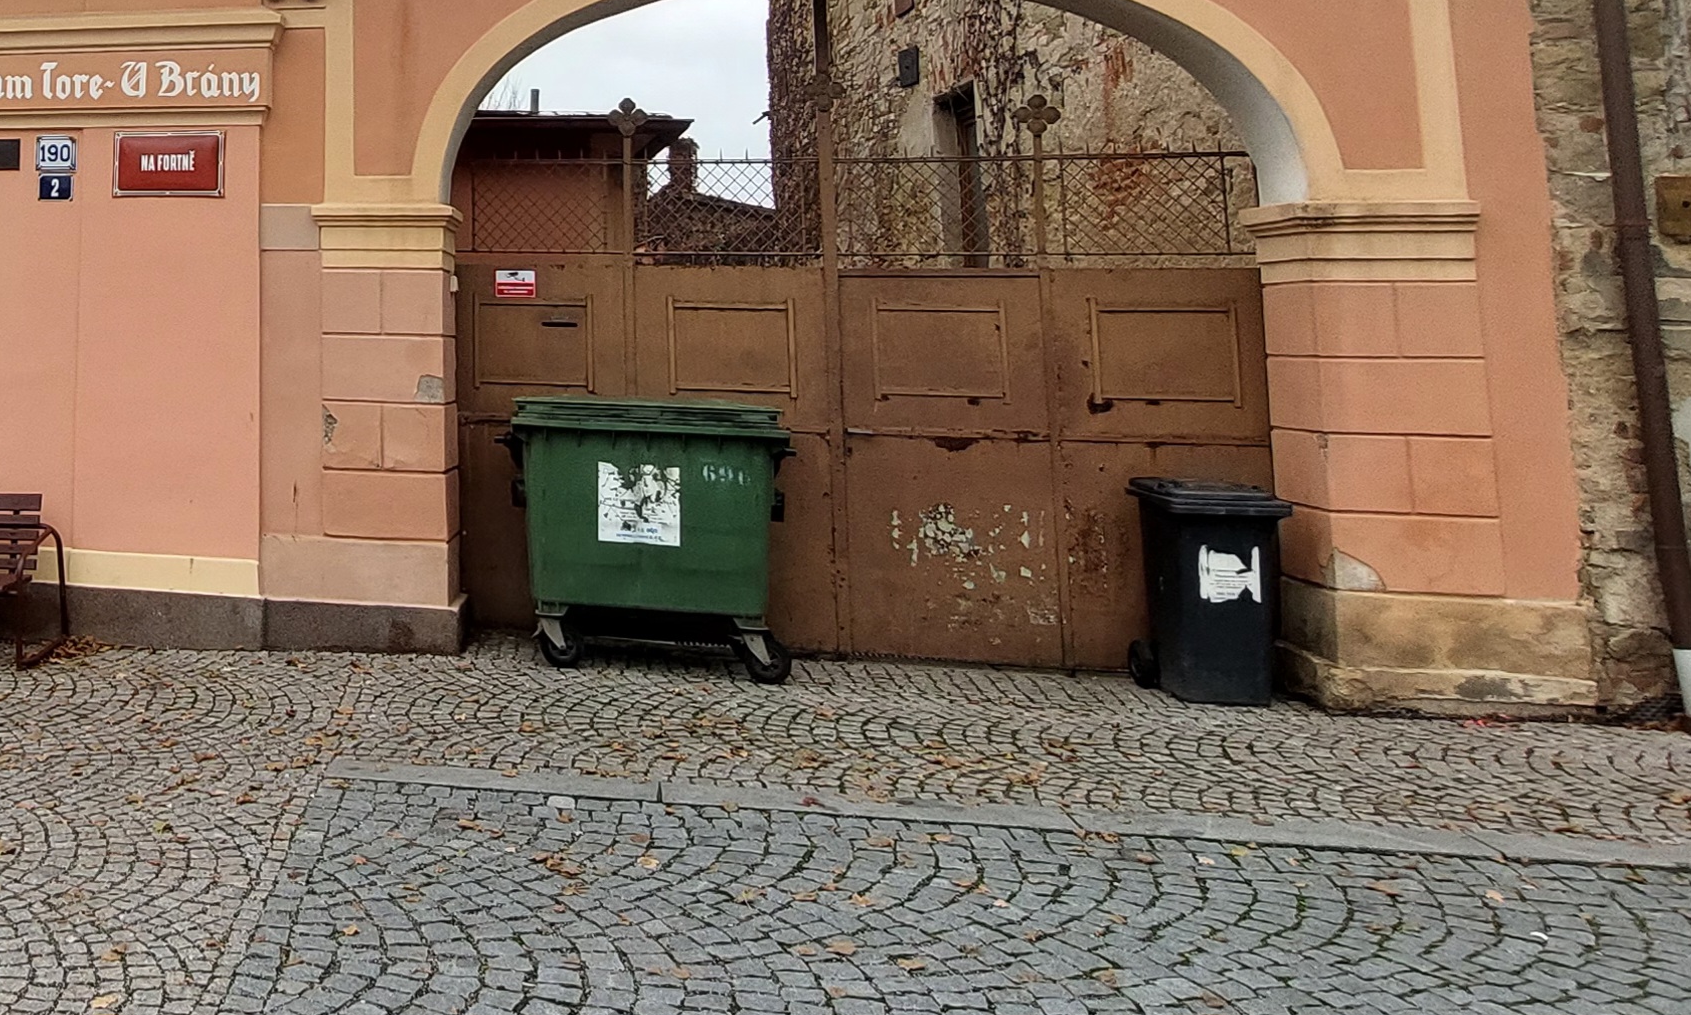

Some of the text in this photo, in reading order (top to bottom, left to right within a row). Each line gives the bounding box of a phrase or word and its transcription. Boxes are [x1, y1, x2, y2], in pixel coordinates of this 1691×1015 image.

[154, 61, 260, 102] Brány
[39, 144, 71, 162] 190
[140, 150, 195, 171] NA FORTNĚ
[50, 179, 60, 197] 2
